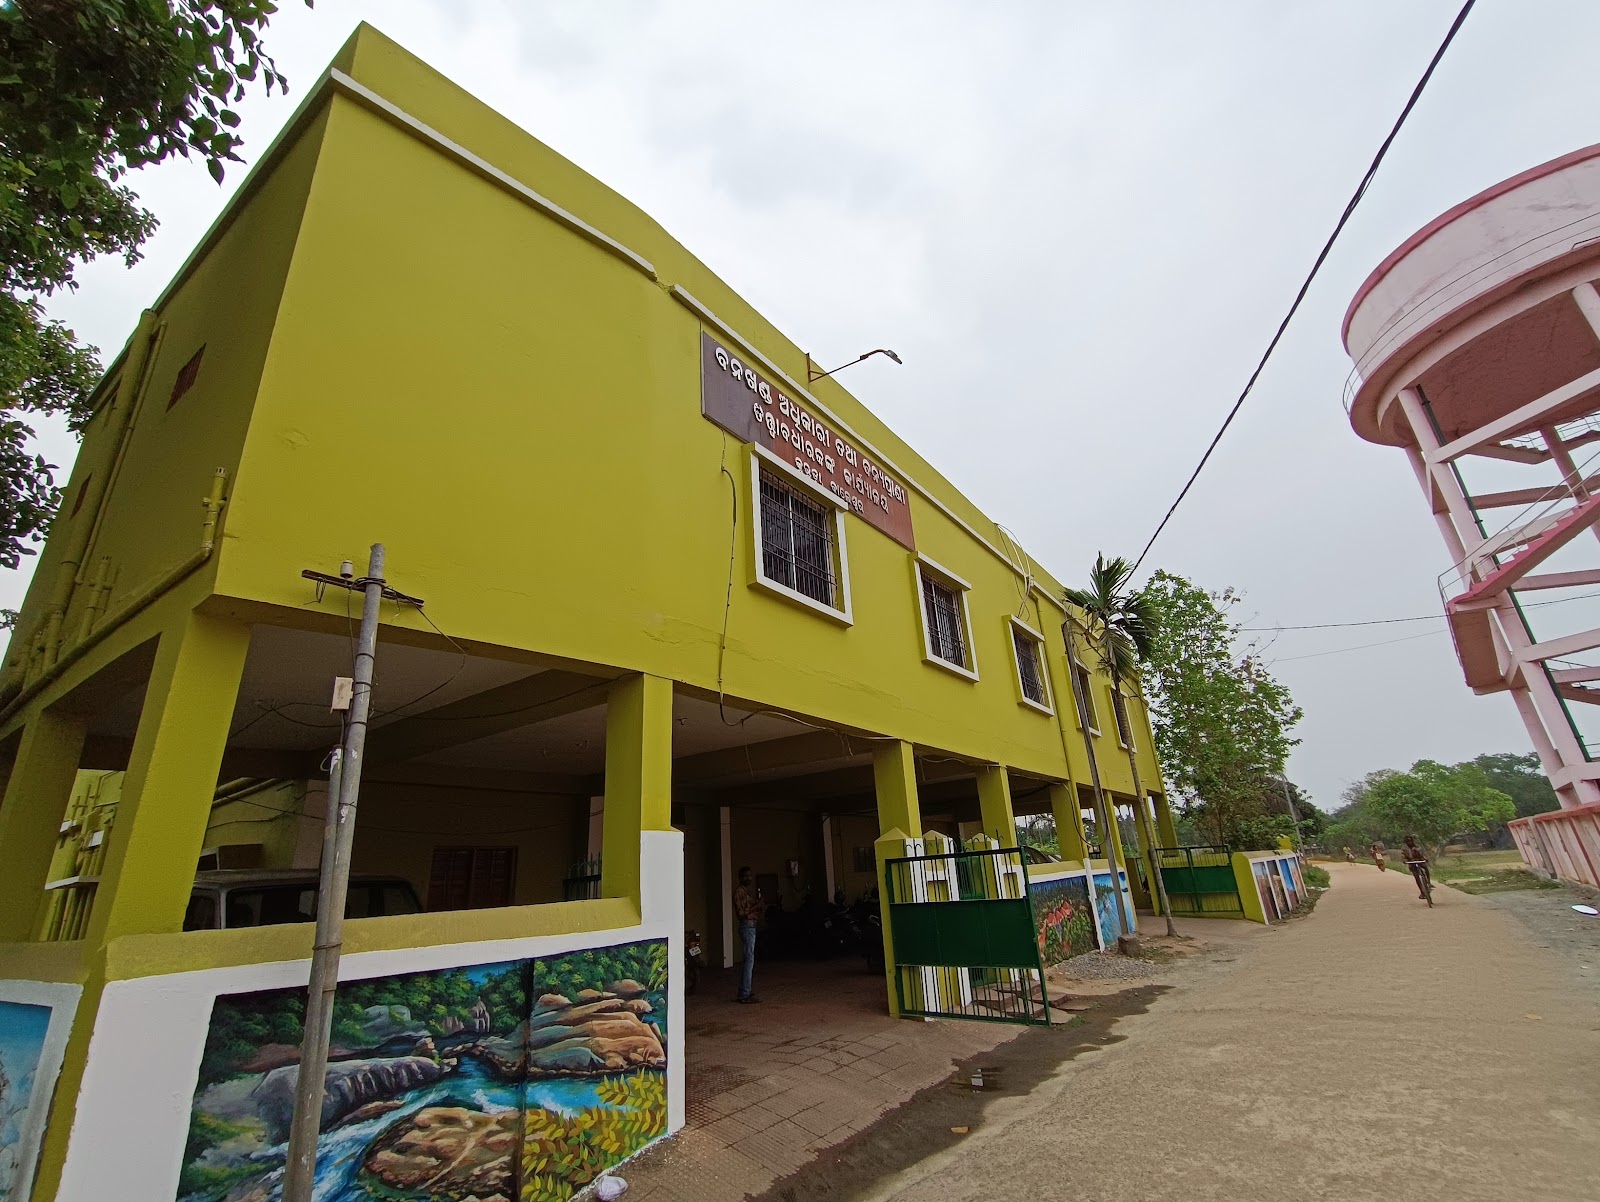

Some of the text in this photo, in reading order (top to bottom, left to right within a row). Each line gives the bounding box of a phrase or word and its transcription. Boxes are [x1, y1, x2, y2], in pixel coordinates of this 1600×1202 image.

[779, 393, 831, 448] ଅଧିକାରୀ
[835, 438, 858, 468] ତଥା
[863, 458, 906, 505] ବନ୍ୟପ୍ରାଣୀ
